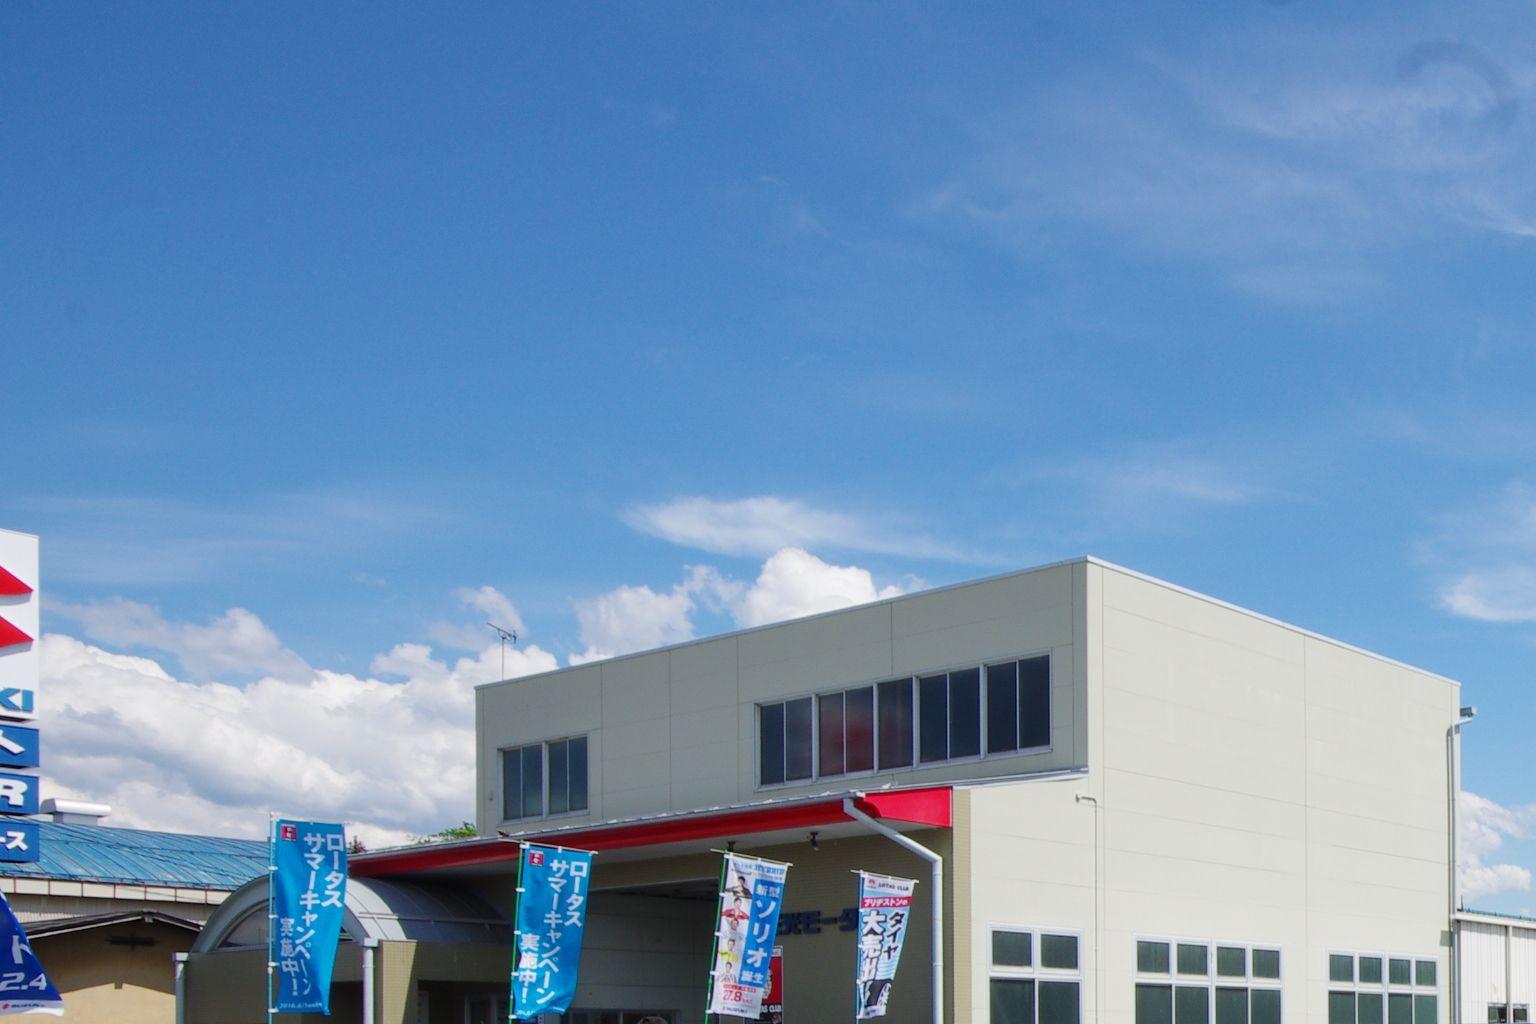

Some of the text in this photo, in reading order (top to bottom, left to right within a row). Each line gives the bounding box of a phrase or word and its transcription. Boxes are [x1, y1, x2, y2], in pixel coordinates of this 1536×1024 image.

[321, 833, 344, 908] ロータス
[564, 861, 588, 927] ロータス
[295, 832, 325, 996] サマーキャンペーン
[536, 859, 569, 1004] サマーキャンペーン
[745, 900, 777, 968] ソリオ
[881, 911, 906, 960] タイヤ
